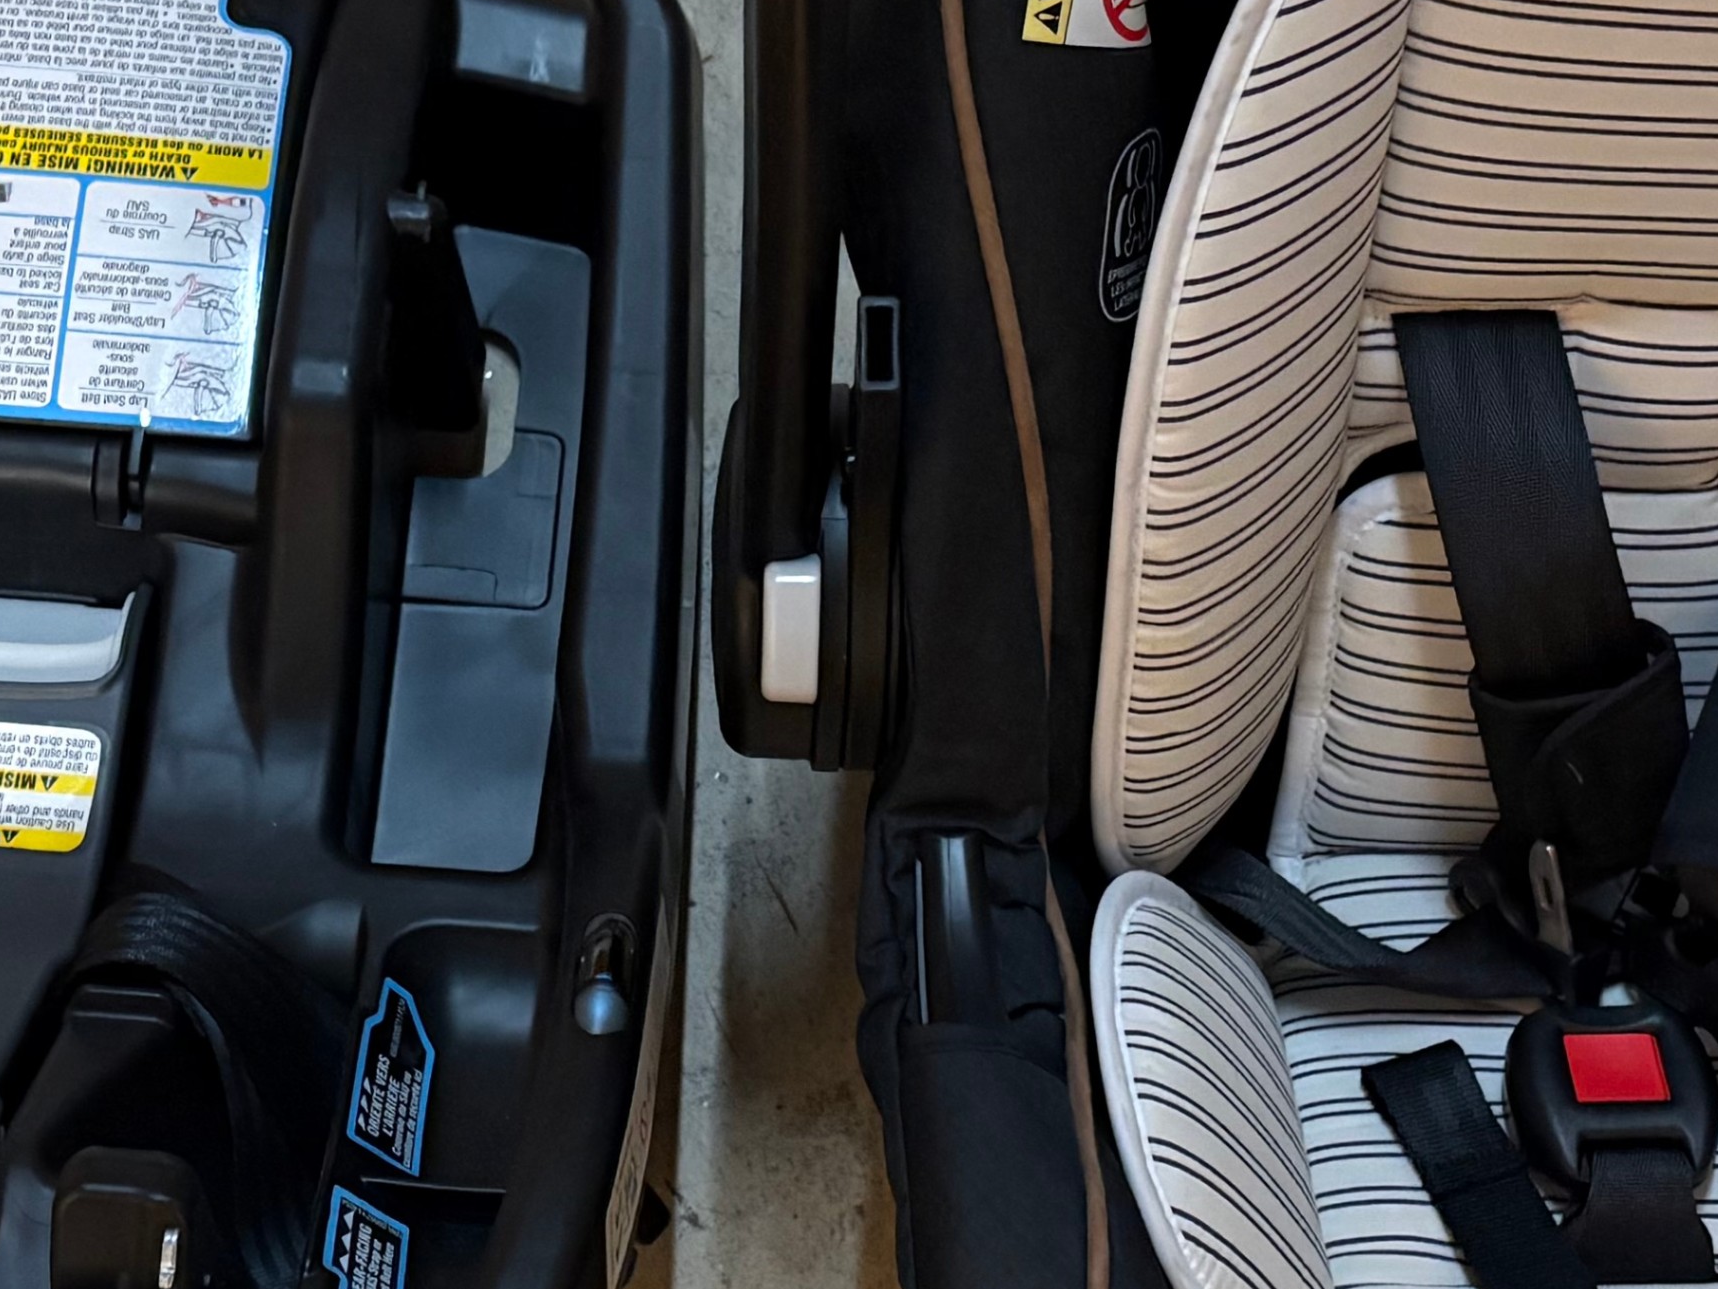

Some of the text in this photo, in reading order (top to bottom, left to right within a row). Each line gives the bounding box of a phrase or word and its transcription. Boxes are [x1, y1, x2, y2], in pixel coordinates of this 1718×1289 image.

[20, 138, 68, 154] INJURY
[78, 131, 158, 150] BLESSURES
[161, 139, 182, 151] des
[183, 141, 202, 152] ou
[70, 143, 128, 160] SERIOUS
[131, 148, 145, 159] or
[149, 149, 191, 164] DEATH
[206, 143, 243, 157] MORT
[245, 147, 263, 159] LA
[9, 150, 32, 167] EN
[37, 152, 79, 171] MISE
[85, 156, 176, 179] WARNING!
